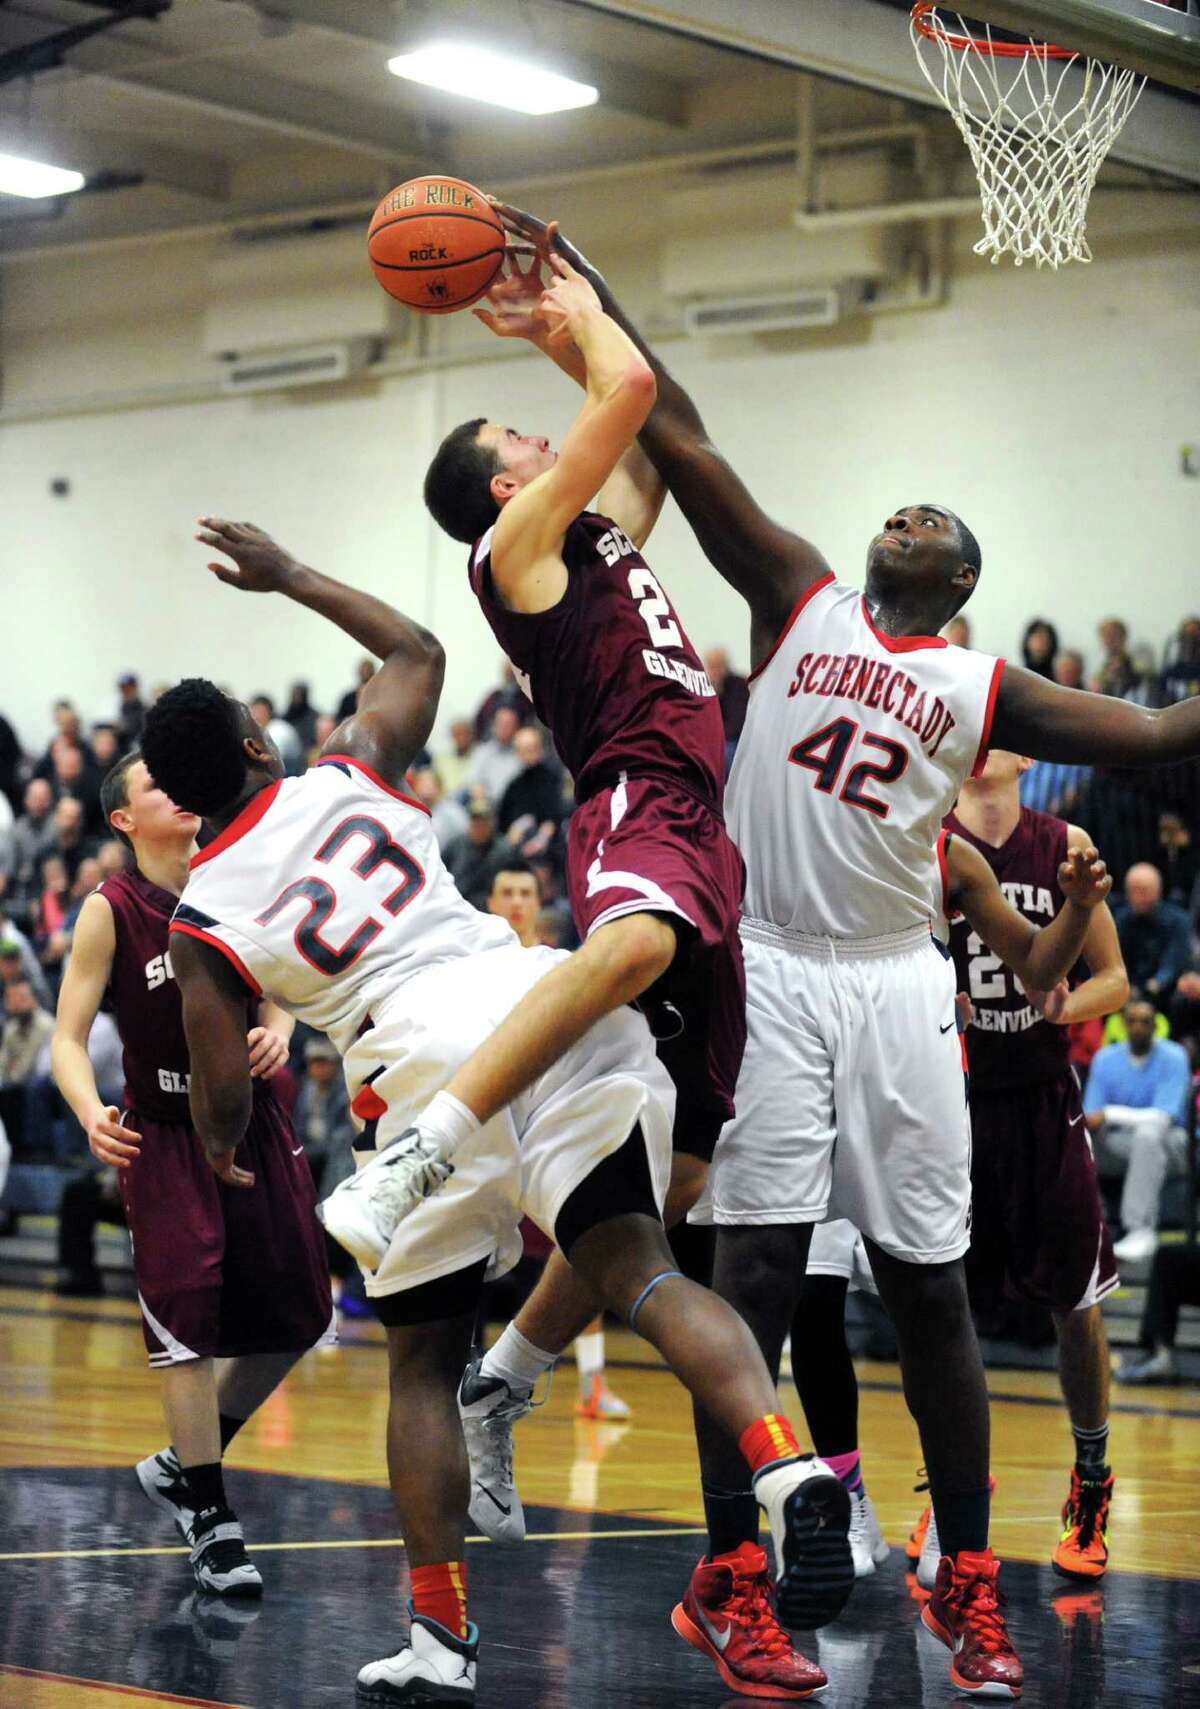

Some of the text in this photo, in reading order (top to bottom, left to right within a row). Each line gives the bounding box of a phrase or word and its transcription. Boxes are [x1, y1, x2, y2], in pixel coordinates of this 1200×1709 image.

[409, 247, 448, 262] ROCK
[787, 652, 956, 758] SCHENECTADY
[787, 715, 909, 819] 42
[253, 814, 426, 976] 23
[1001, 882, 1055, 917] TIA
[967, 930, 1027, 999] 2
[972, 1005, 1044, 1033] LENVILL
